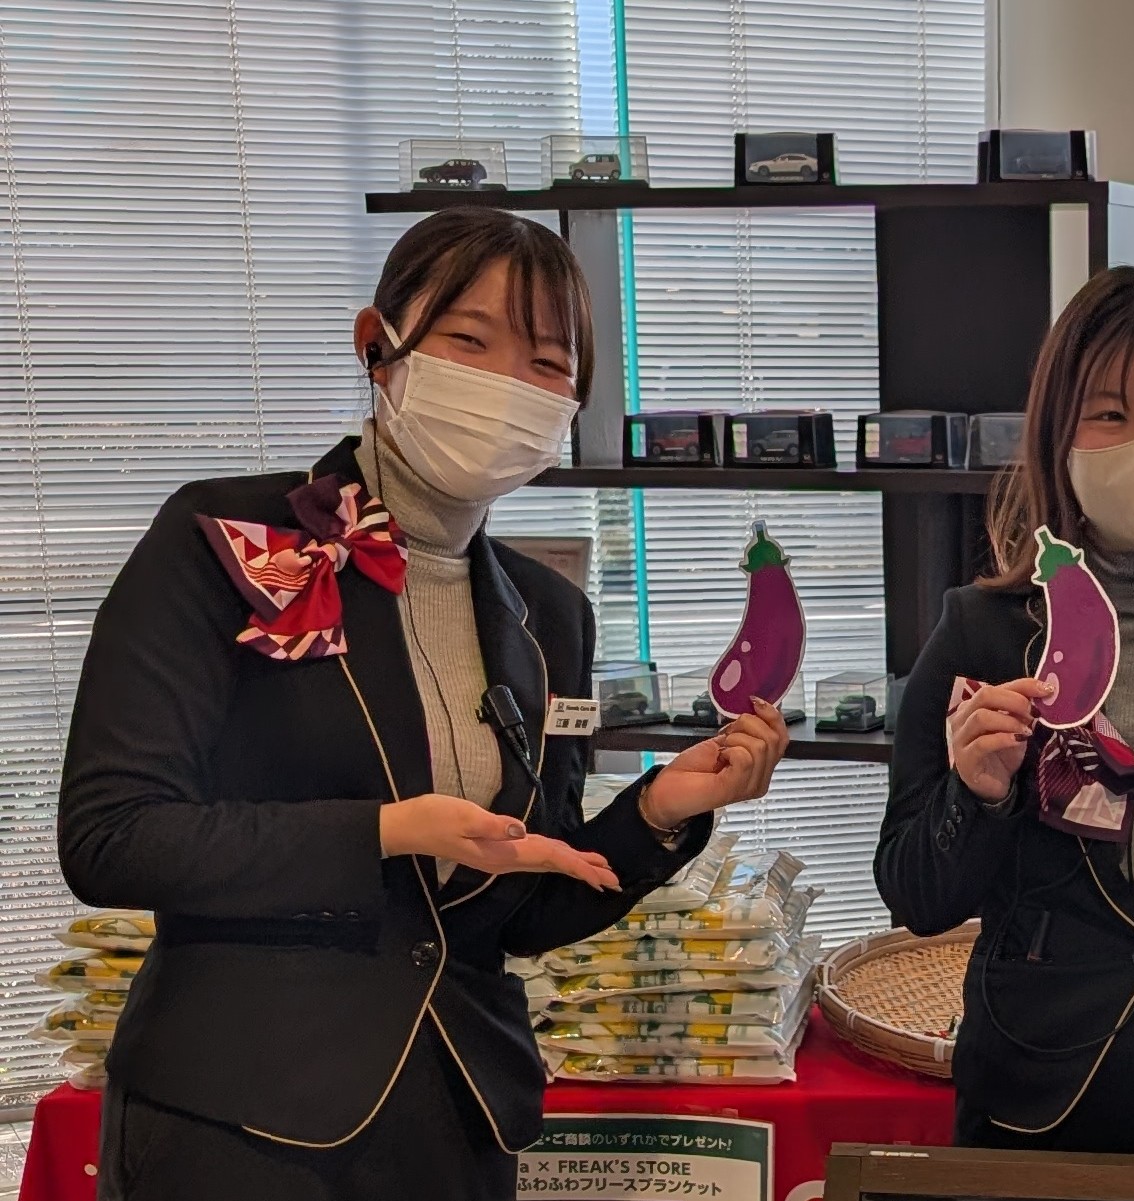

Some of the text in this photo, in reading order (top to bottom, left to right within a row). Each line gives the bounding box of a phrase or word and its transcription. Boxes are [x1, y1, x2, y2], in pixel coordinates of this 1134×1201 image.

[636, 1161, 691, 1175] STORE
[518, 1177, 721, 1196] ふわふわフリースブランケット
